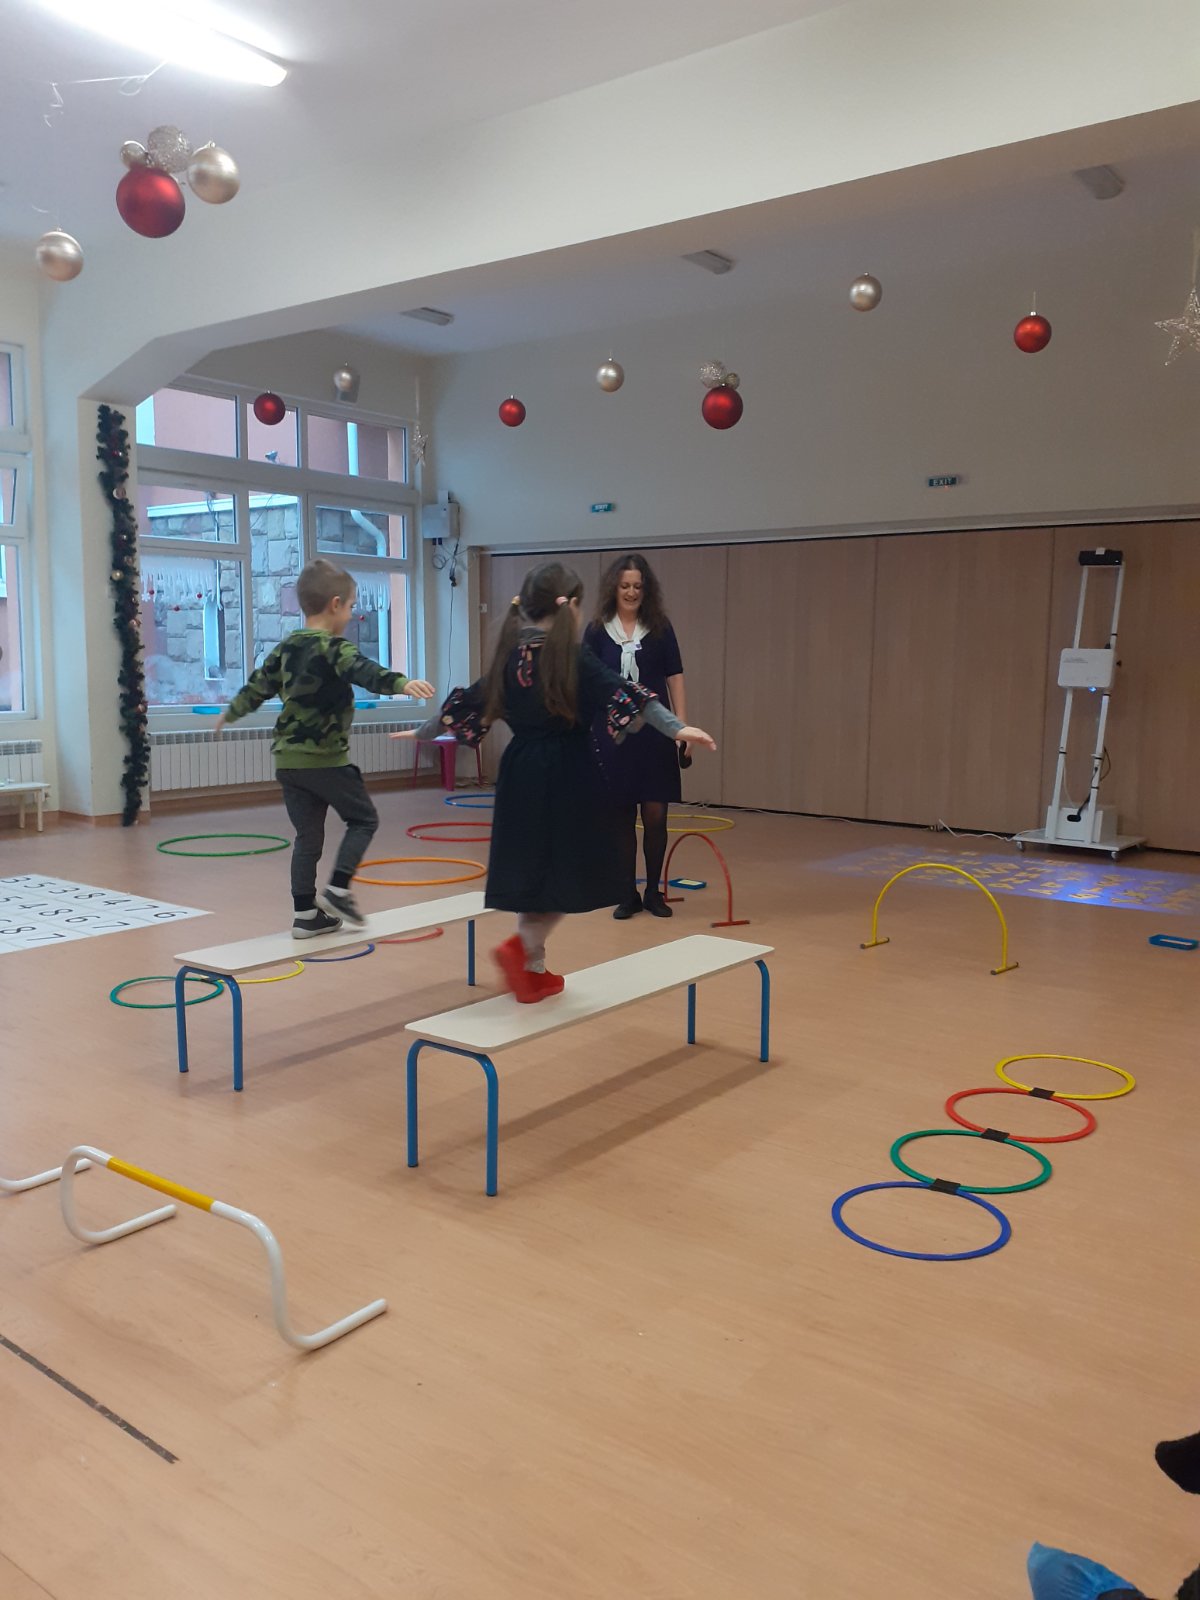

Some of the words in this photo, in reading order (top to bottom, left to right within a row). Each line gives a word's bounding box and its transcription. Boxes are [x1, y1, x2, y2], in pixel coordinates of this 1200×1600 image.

[933, 477, 952, 486] EXIT
[38, 908, 74, 916] 8
[0, 926, 37, 935] 8
